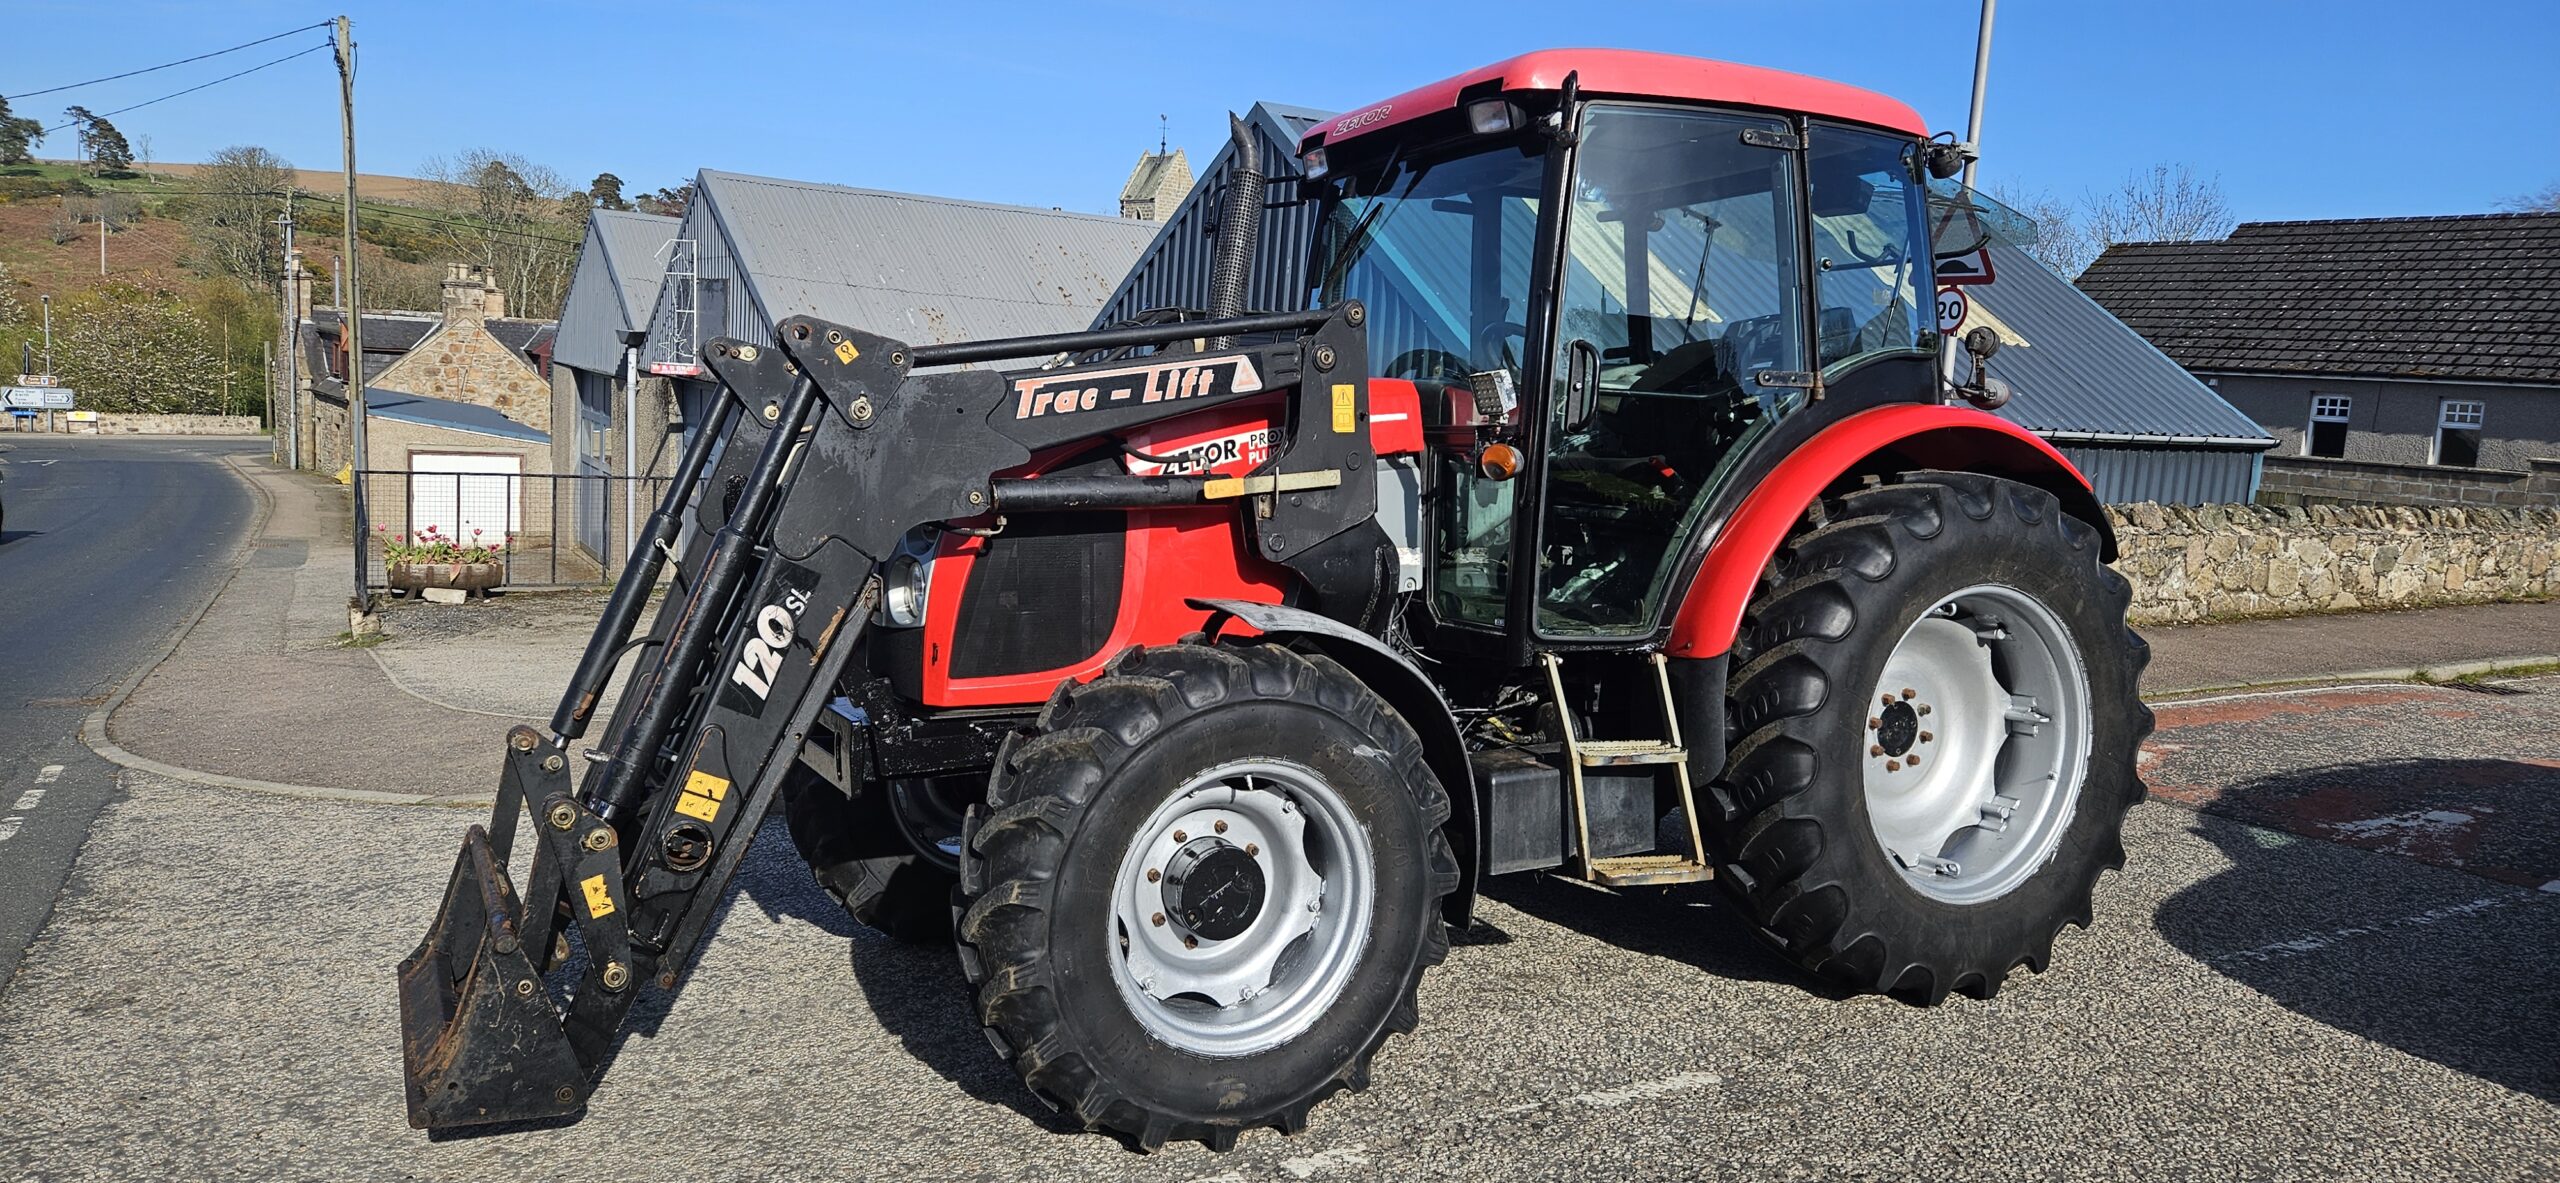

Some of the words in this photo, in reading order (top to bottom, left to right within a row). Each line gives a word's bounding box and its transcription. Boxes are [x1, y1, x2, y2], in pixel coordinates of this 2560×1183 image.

[1333, 105, 1392, 136] ZETOR
[1938, 301, 1962, 320] 20
[1015, 378, 1098, 419] Trac
[1142, 366, 1214, 404] Lift
[732, 604, 795, 701] 120
[785, 588, 812, 615] SL
